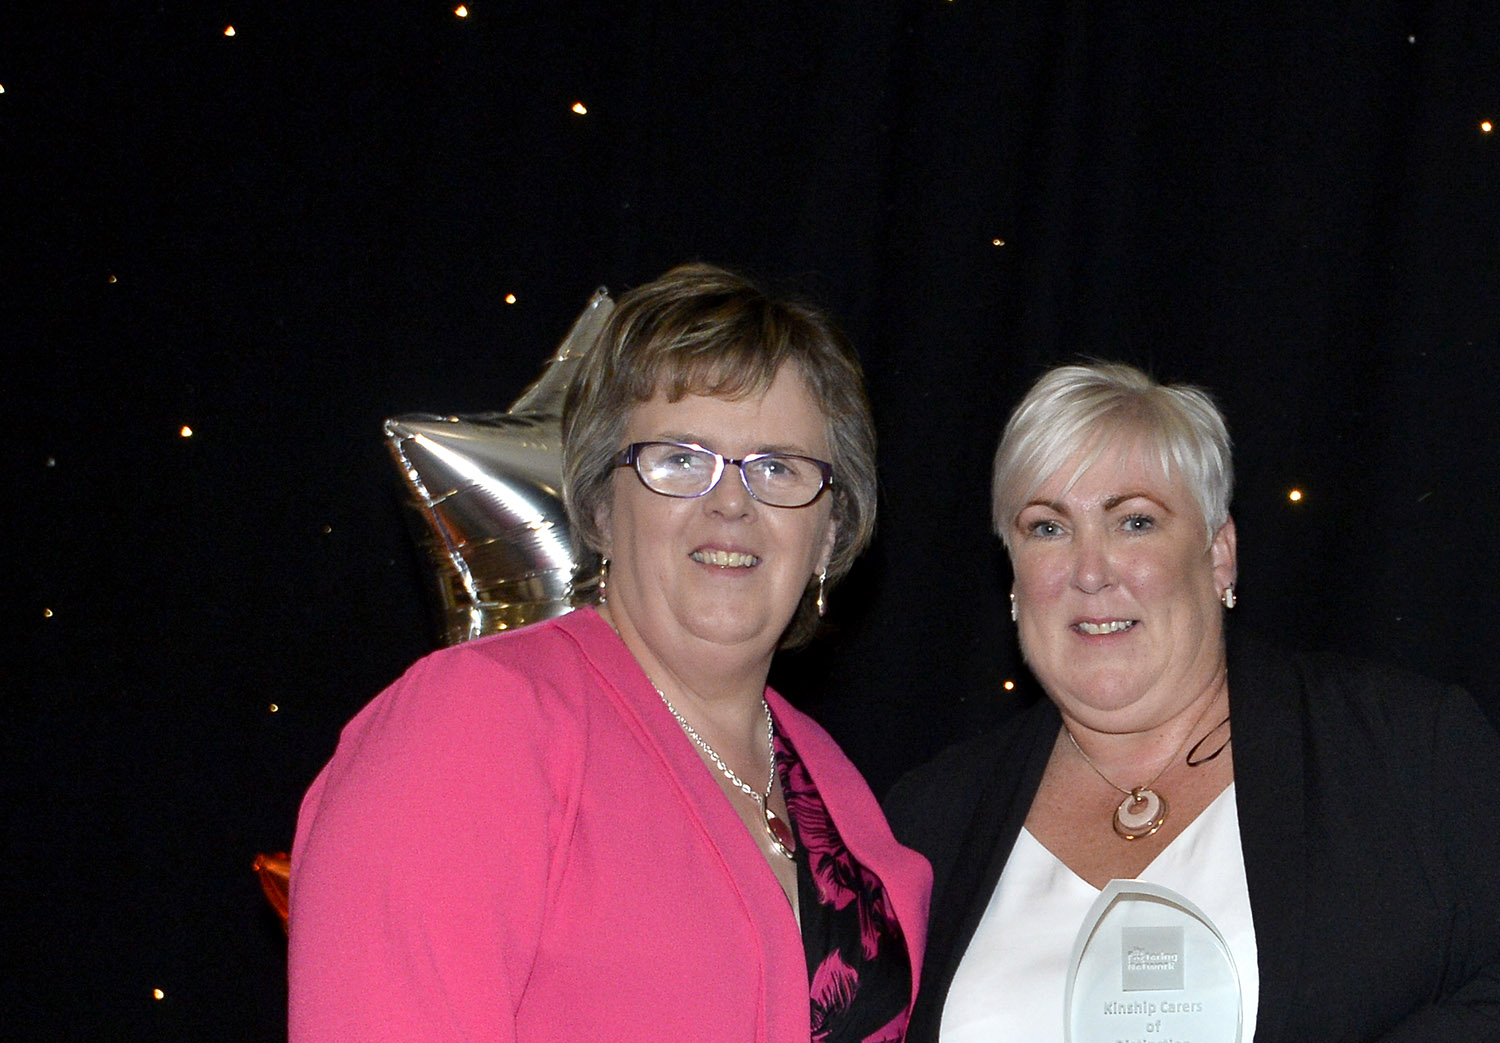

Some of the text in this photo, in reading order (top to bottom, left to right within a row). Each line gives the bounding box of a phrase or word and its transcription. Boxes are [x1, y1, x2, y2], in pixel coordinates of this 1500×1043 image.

[1127, 961, 1175, 971] Network
[1104, 1001, 1202, 1016] Kinship Carers
[1146, 1020, 1161, 1033] of
